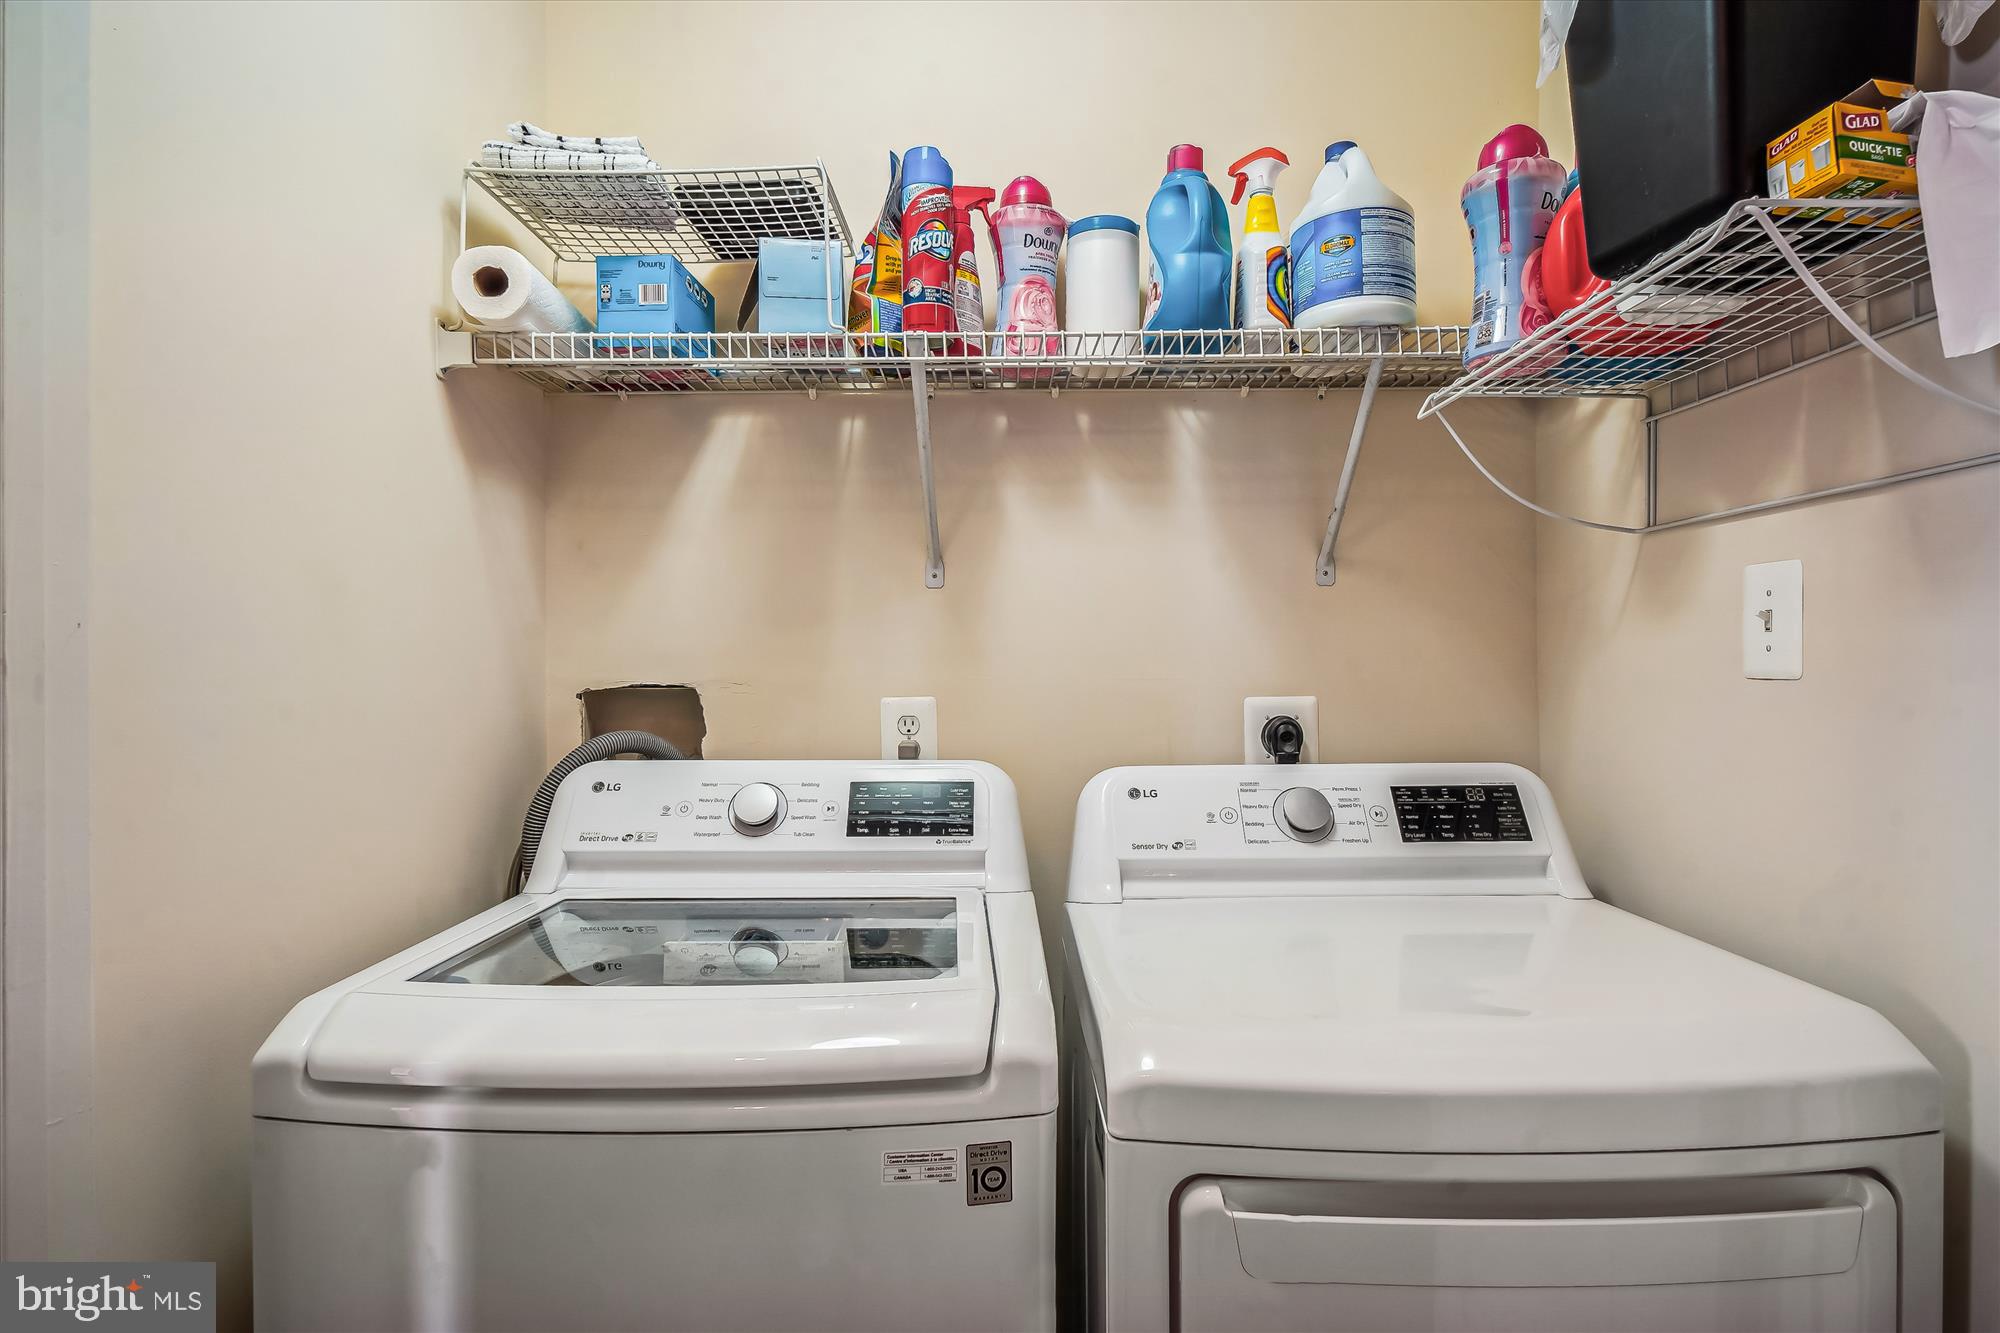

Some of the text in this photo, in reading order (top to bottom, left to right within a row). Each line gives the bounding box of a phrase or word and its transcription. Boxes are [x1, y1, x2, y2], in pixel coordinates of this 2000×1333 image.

[1845, 114, 1880, 129] GLAD
[1771, 131, 1798, 156] GLAD
[1849, 140, 1903, 157] QUICK-TIE
[1024, 233, 1059, 260] Downy
[637, 260, 666, 270] Downy
[606, 783, 622, 792] LG
[1143, 789, 1158, 798] LG
[1156, 843, 1169, 851] Dry
[970, 1151, 989, 1159] Direct
[971, 1166, 1007, 1194] 10
